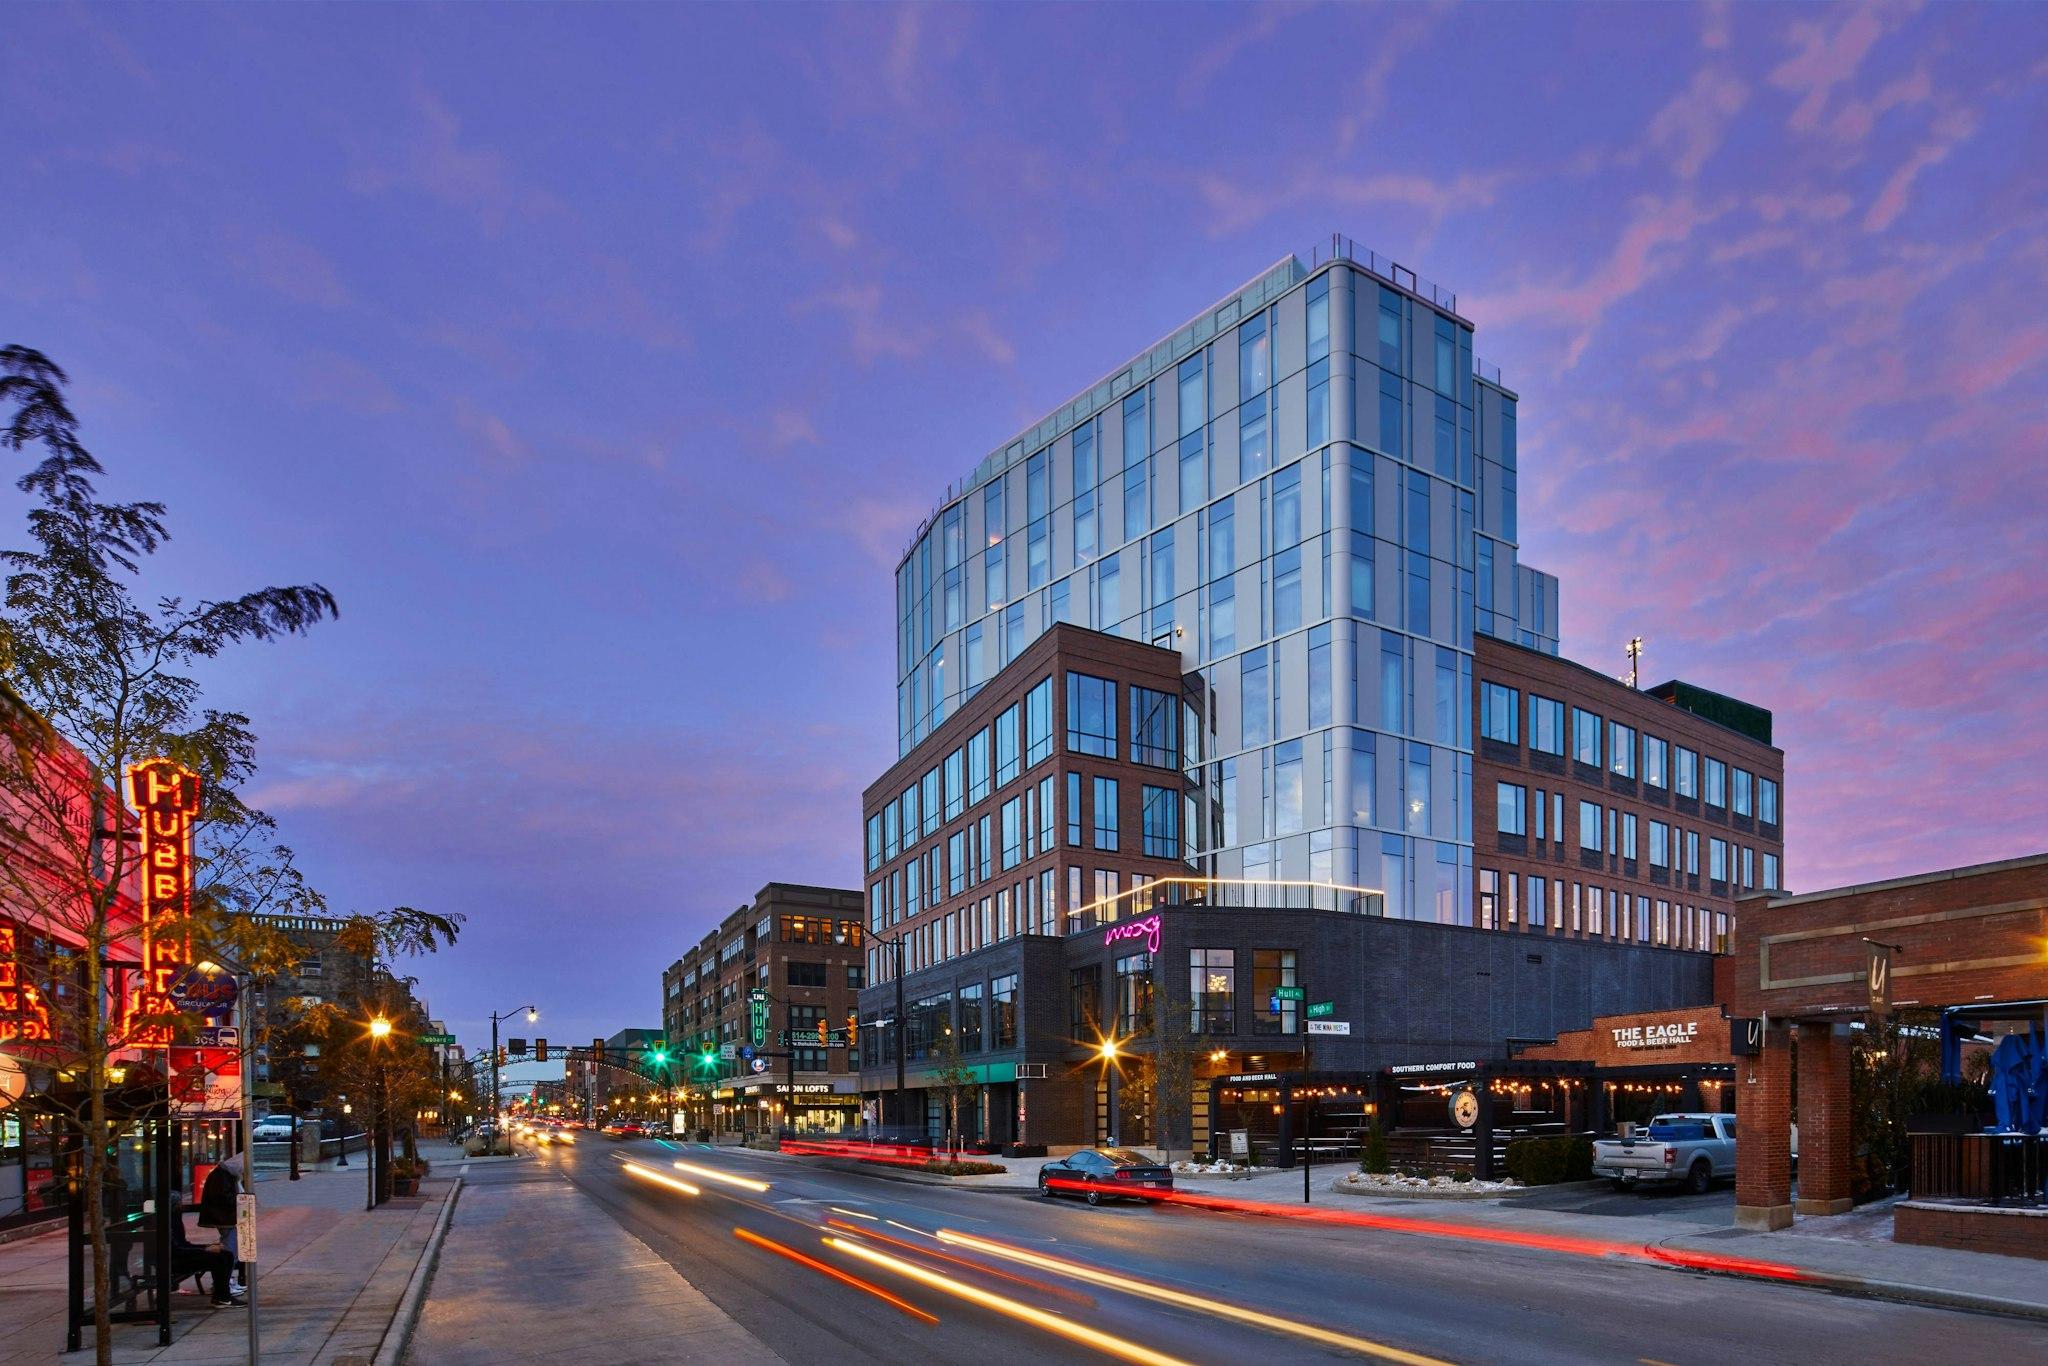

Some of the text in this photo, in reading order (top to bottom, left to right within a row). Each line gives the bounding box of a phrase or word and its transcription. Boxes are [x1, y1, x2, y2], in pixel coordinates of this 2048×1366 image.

[1105, 915, 1161, 953] moxy
[1278, 989, 1294, 997] Hull
[755, 1002, 763, 1040] HUB
[1612, 1022, 1698, 1041] THE EAGLE
[1617, 1040, 1638, 1048] FOOD
[1646, 1037, 1667, 1046] BEER
[1669, 1035, 1692, 1044] HALL
[1392, 1062, 1476, 1073] SOUTHERN COMFORT FOOD
[805, 1085, 829, 1093] LOFTS
